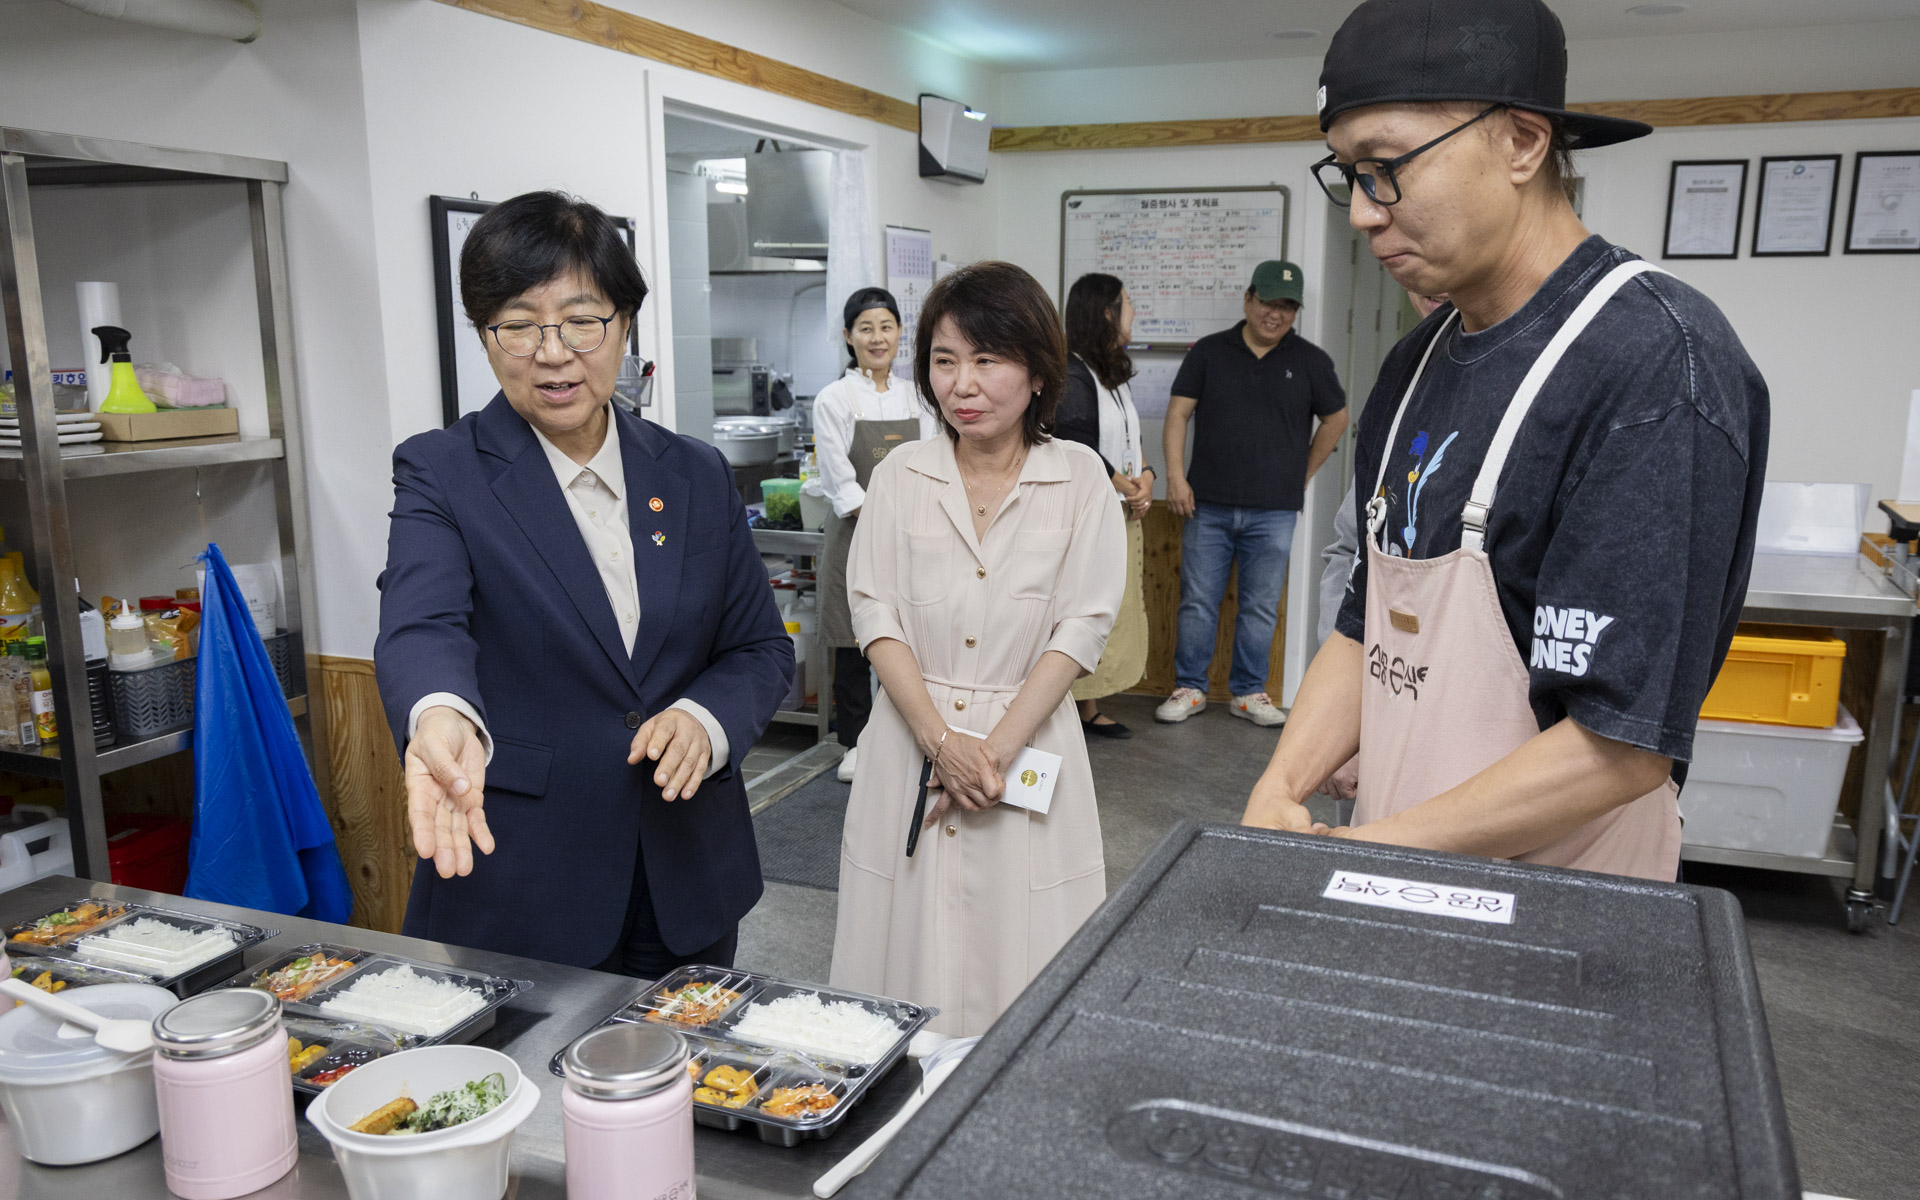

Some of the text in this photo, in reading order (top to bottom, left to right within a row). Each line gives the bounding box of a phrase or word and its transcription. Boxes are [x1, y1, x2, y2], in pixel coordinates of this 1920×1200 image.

[1180, 199, 1189, 208] 및
[1193, 198, 1219, 208] 계획표
[1533, 605, 1615, 644] ONEY
